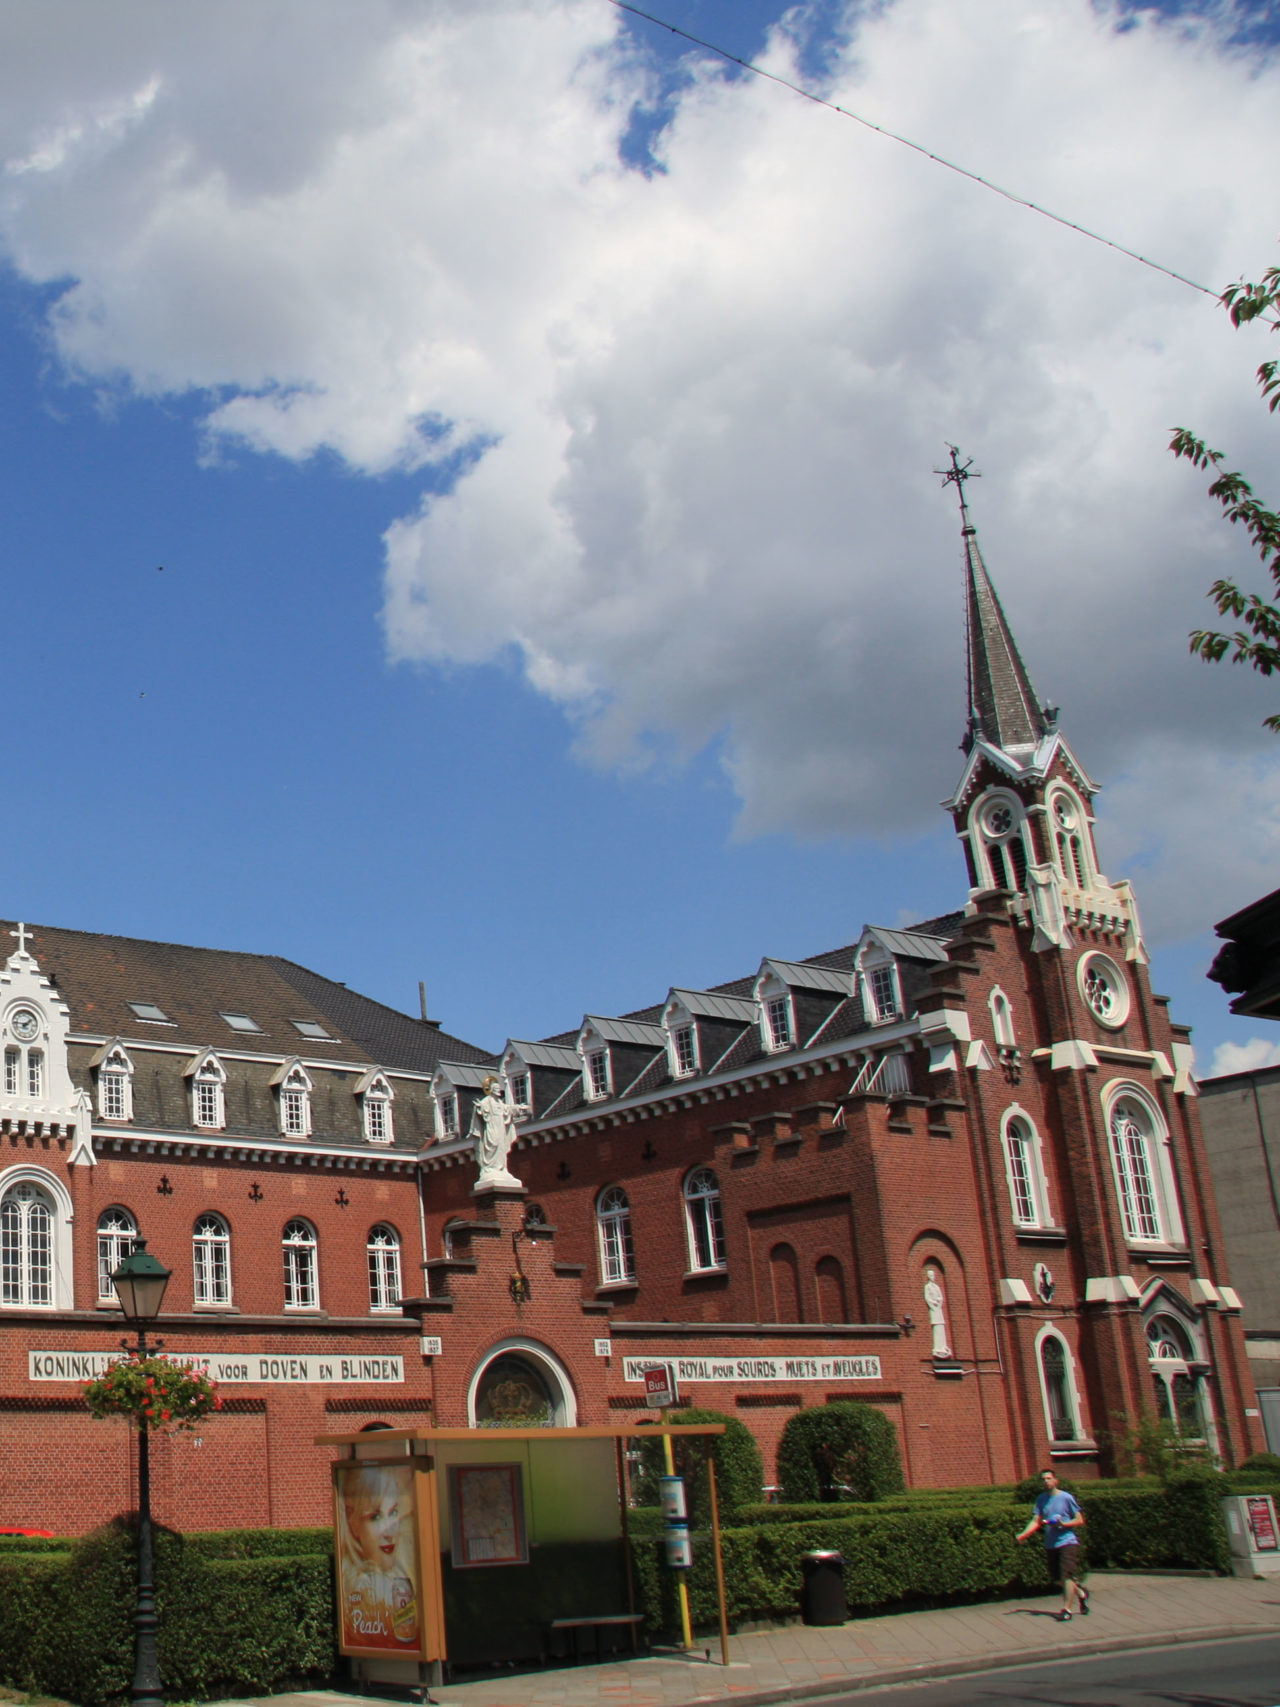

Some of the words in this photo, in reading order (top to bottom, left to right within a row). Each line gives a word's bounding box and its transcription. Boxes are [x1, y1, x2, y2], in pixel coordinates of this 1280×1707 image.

[218, 1363, 249, 1380] VOOR
[259, 1359, 308, 1380] DOVEN
[319, 1364, 333, 1379] EN
[341, 1360, 399, 1380] BLINDEN
[678, 1359, 711, 1379] ROYAL
[712, 1364, 734, 1377] POUR
[736, 1360, 777, 1378] SOURDS
[821, 1363, 831, 1377] ET
[833, 1359, 878, 1377] AVEUGLES
[648, 1381, 666, 1391] Bus
